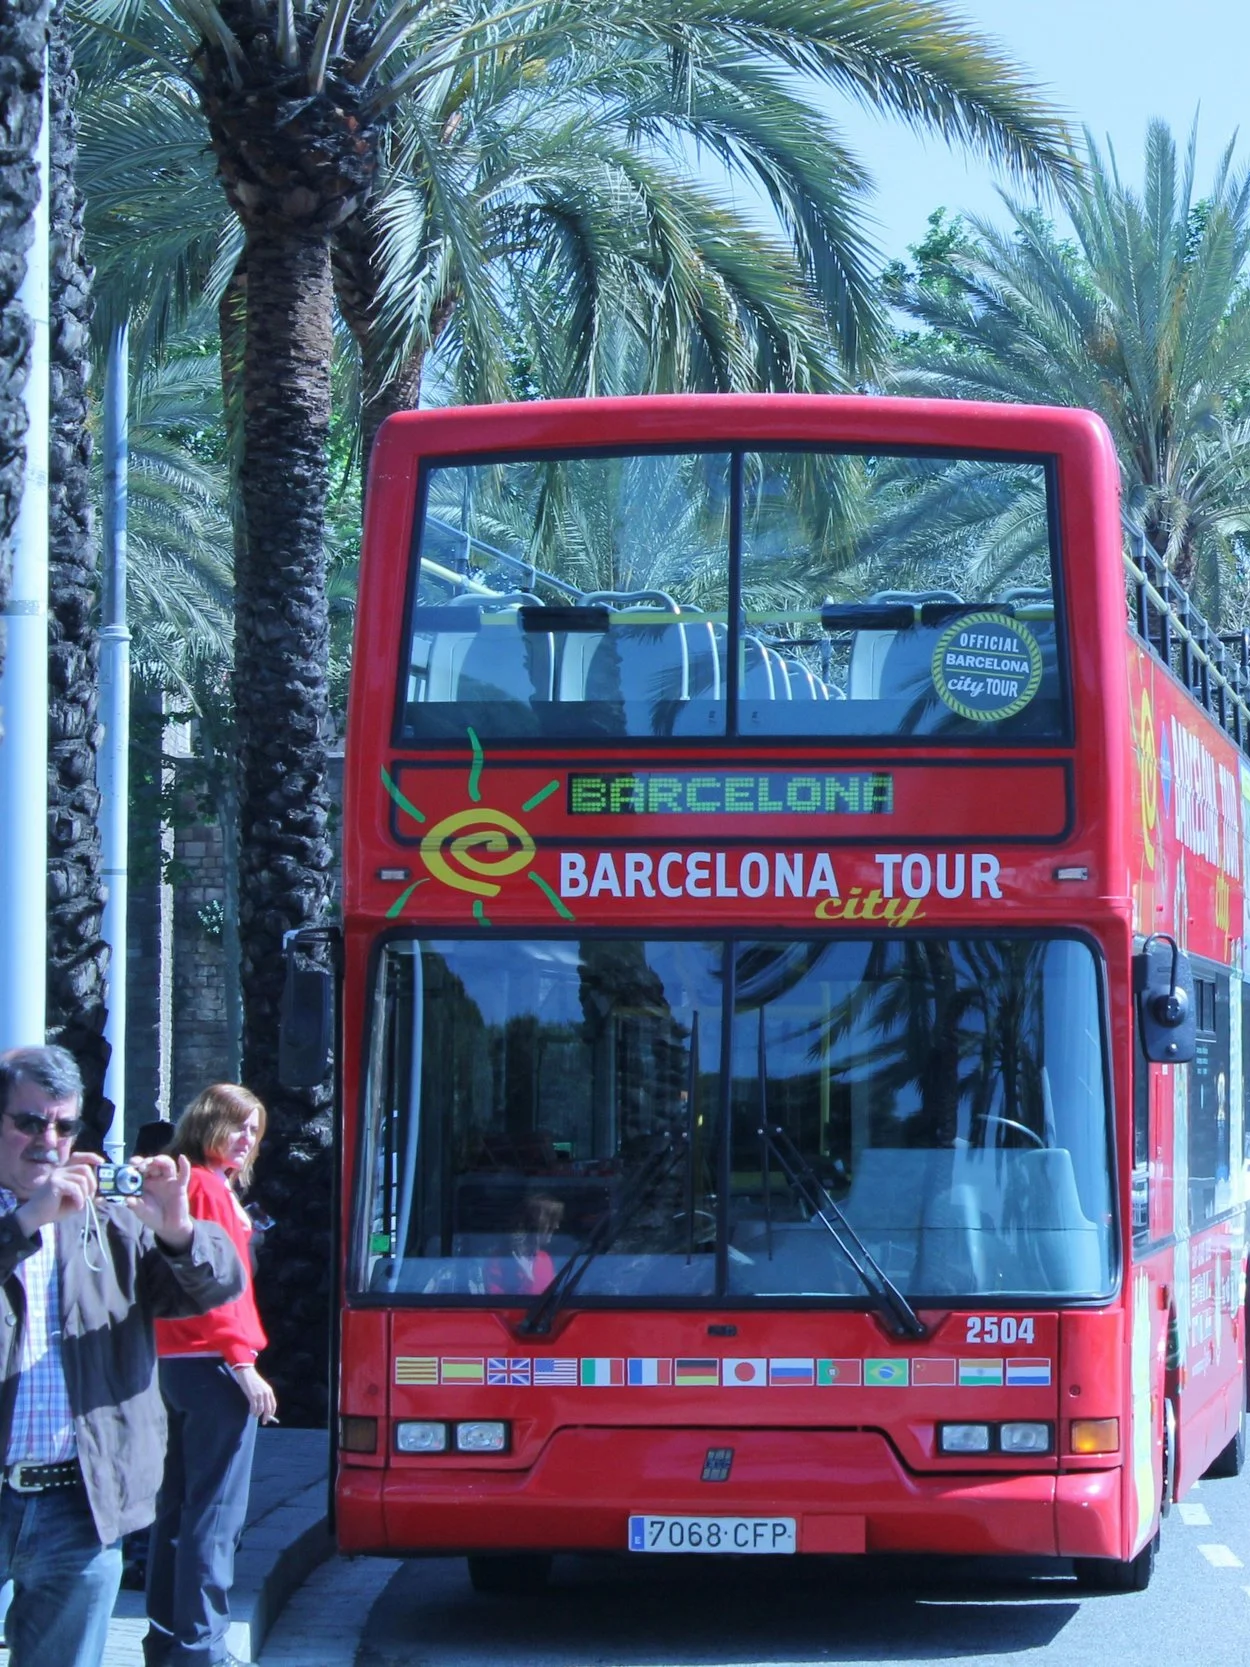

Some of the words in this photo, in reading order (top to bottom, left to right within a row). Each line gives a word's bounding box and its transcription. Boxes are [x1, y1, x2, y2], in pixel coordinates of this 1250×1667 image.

[960, 633, 1019, 652] OFFICIAL
[946, 653, 1030, 673] BARCELONA
[947, 675, 985, 697] city
[986, 678, 1018, 697] TOUR
[570, 776, 893, 814] BARCELONA
[560, 852, 840, 899] BARCELONA
[876, 853, 1003, 900] TOUR
[815, 886, 927, 928] city
[966, 1316, 1035, 1345] 2504
[634, 1536, 641, 1545] E
[650, 1520, 722, 1548] 7068
[734, 1522, 788, 1548] CFP
